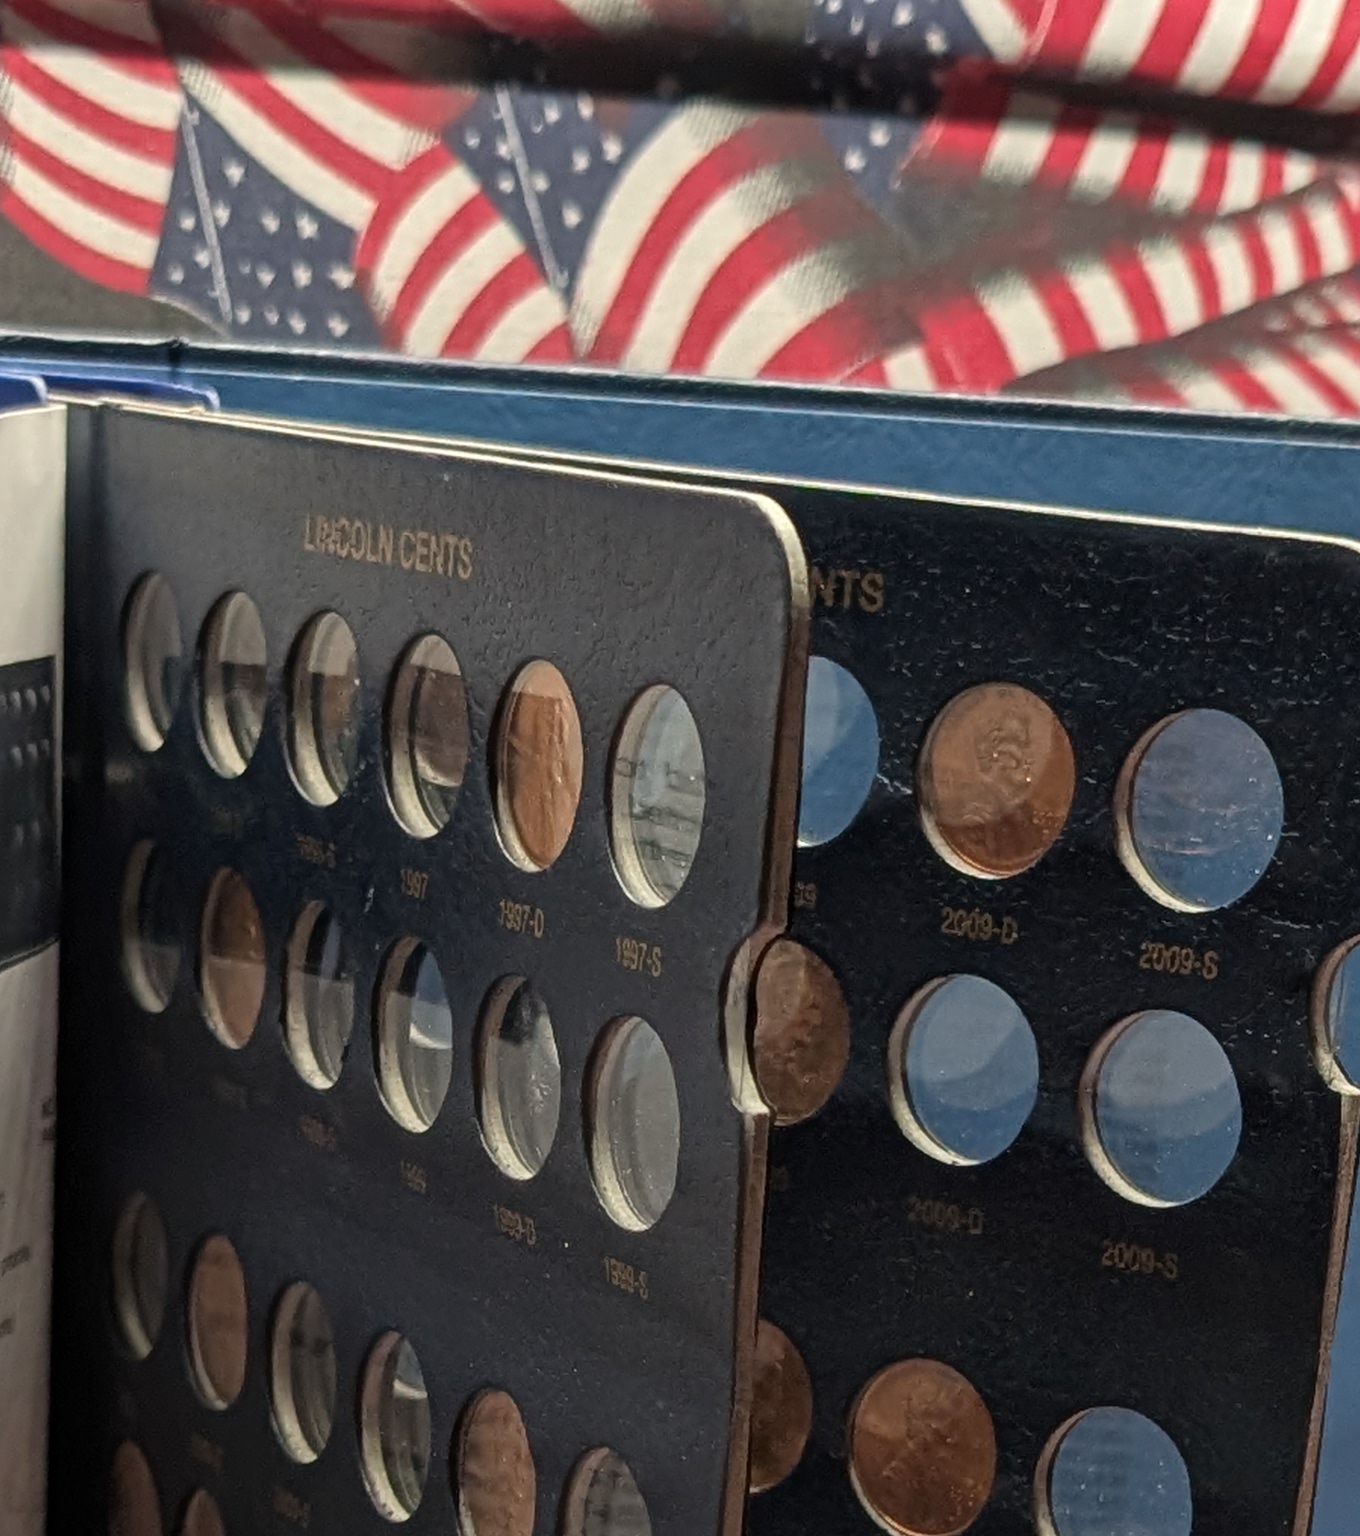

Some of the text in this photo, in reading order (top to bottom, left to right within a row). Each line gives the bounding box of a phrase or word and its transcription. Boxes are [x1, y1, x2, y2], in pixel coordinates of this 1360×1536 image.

[303, 513, 473, 581] LINCOLN CENTS
[399, 867, 429, 900] 1997
[498, 898, 546, 940] 1997-D
[939, 905, 1019, 946] 2009-D
[615, 935, 663, 979] 1997-S
[1139, 940, 1220, 981] 2009-S
[1100, 1239, 1179, 1281] 2009-S
